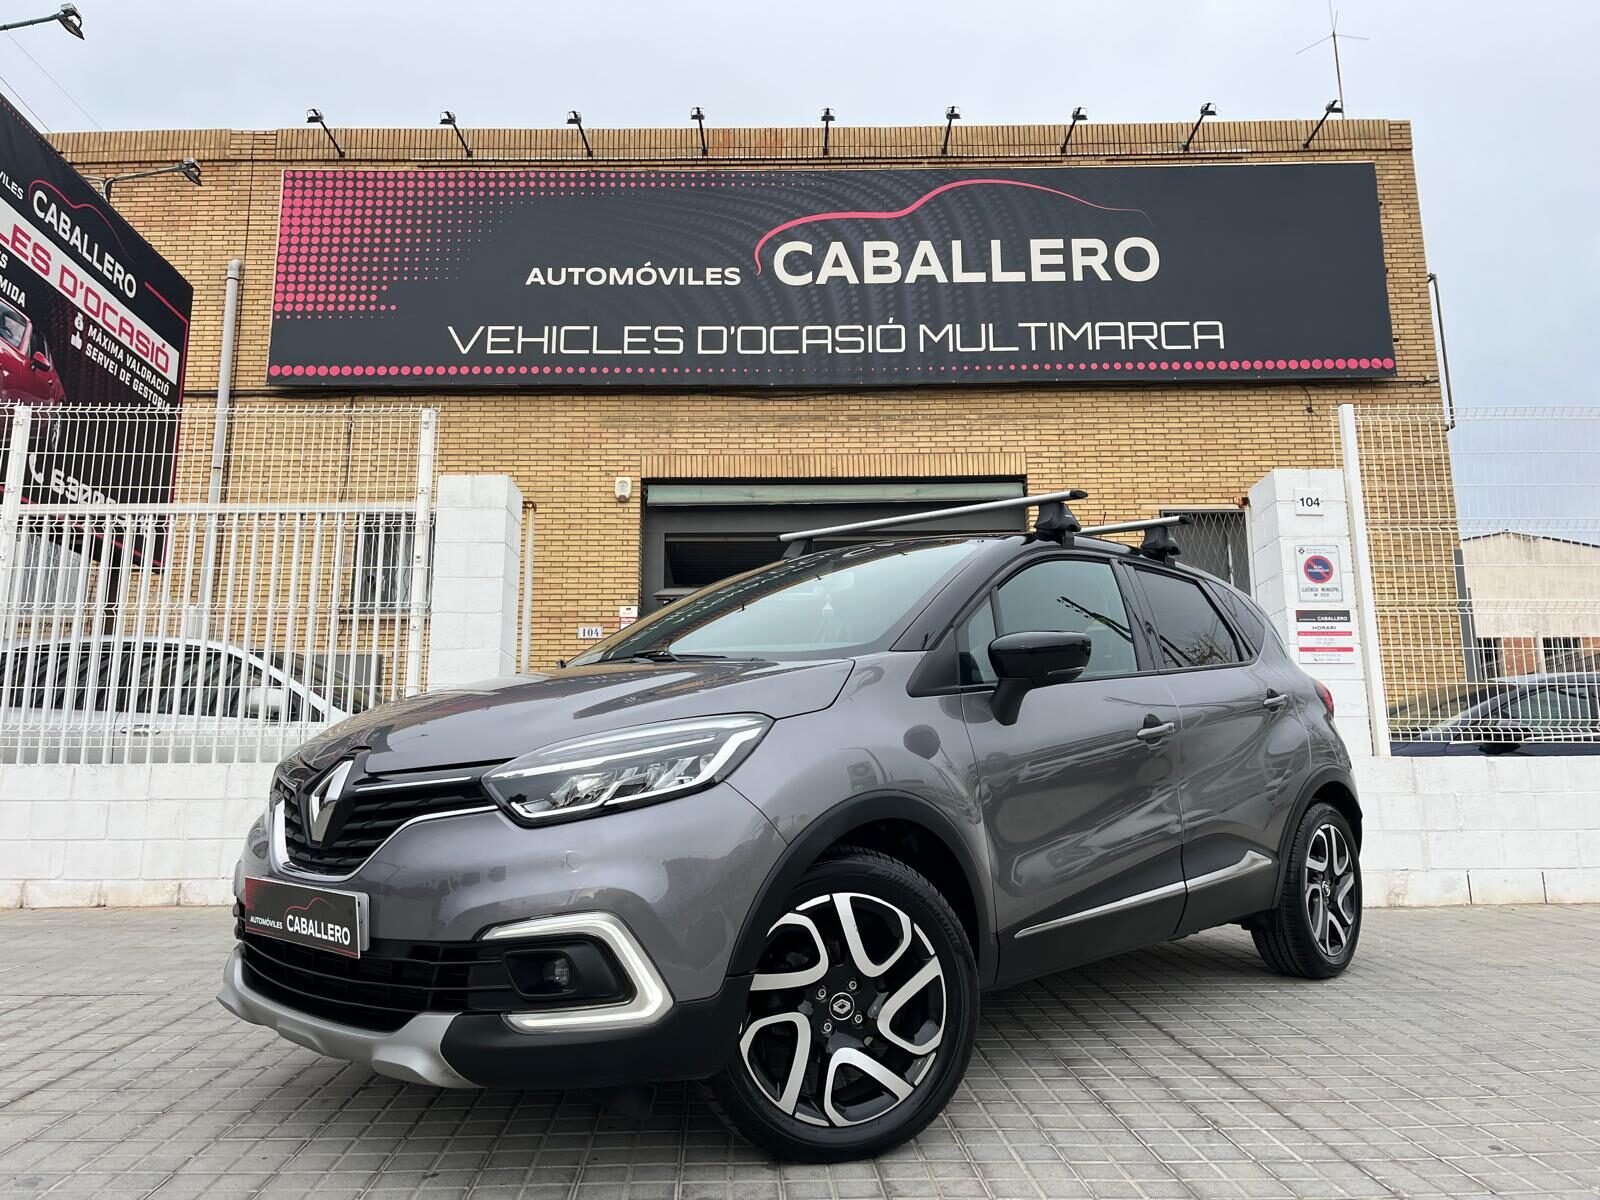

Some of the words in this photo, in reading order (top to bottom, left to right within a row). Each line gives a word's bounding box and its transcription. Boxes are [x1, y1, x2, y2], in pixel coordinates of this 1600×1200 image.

[33, 190, 137, 299] CABALLERO
[525, 261, 741, 286] AUTOMÓVILES
[773, 236, 1160, 286] CABALLERO
[59, 264, 170, 374] D'OCASIÓ
[447, 325, 684, 355] VEHICLES
[697, 316, 906, 355] D'OCASIÓ
[919, 320, 1225, 353] MULTIMARCA
[85, 343, 118, 376] SERVEI
[119, 367, 132, 386] DE
[126, 353, 170, 396] VALORACIÓ
[1299, 497, 1320, 507] 104
[582, 628, 599, 637] 104
[250, 916, 282, 929] AUTOMÓVILES
[286, 914, 351, 946] CABALLERO
